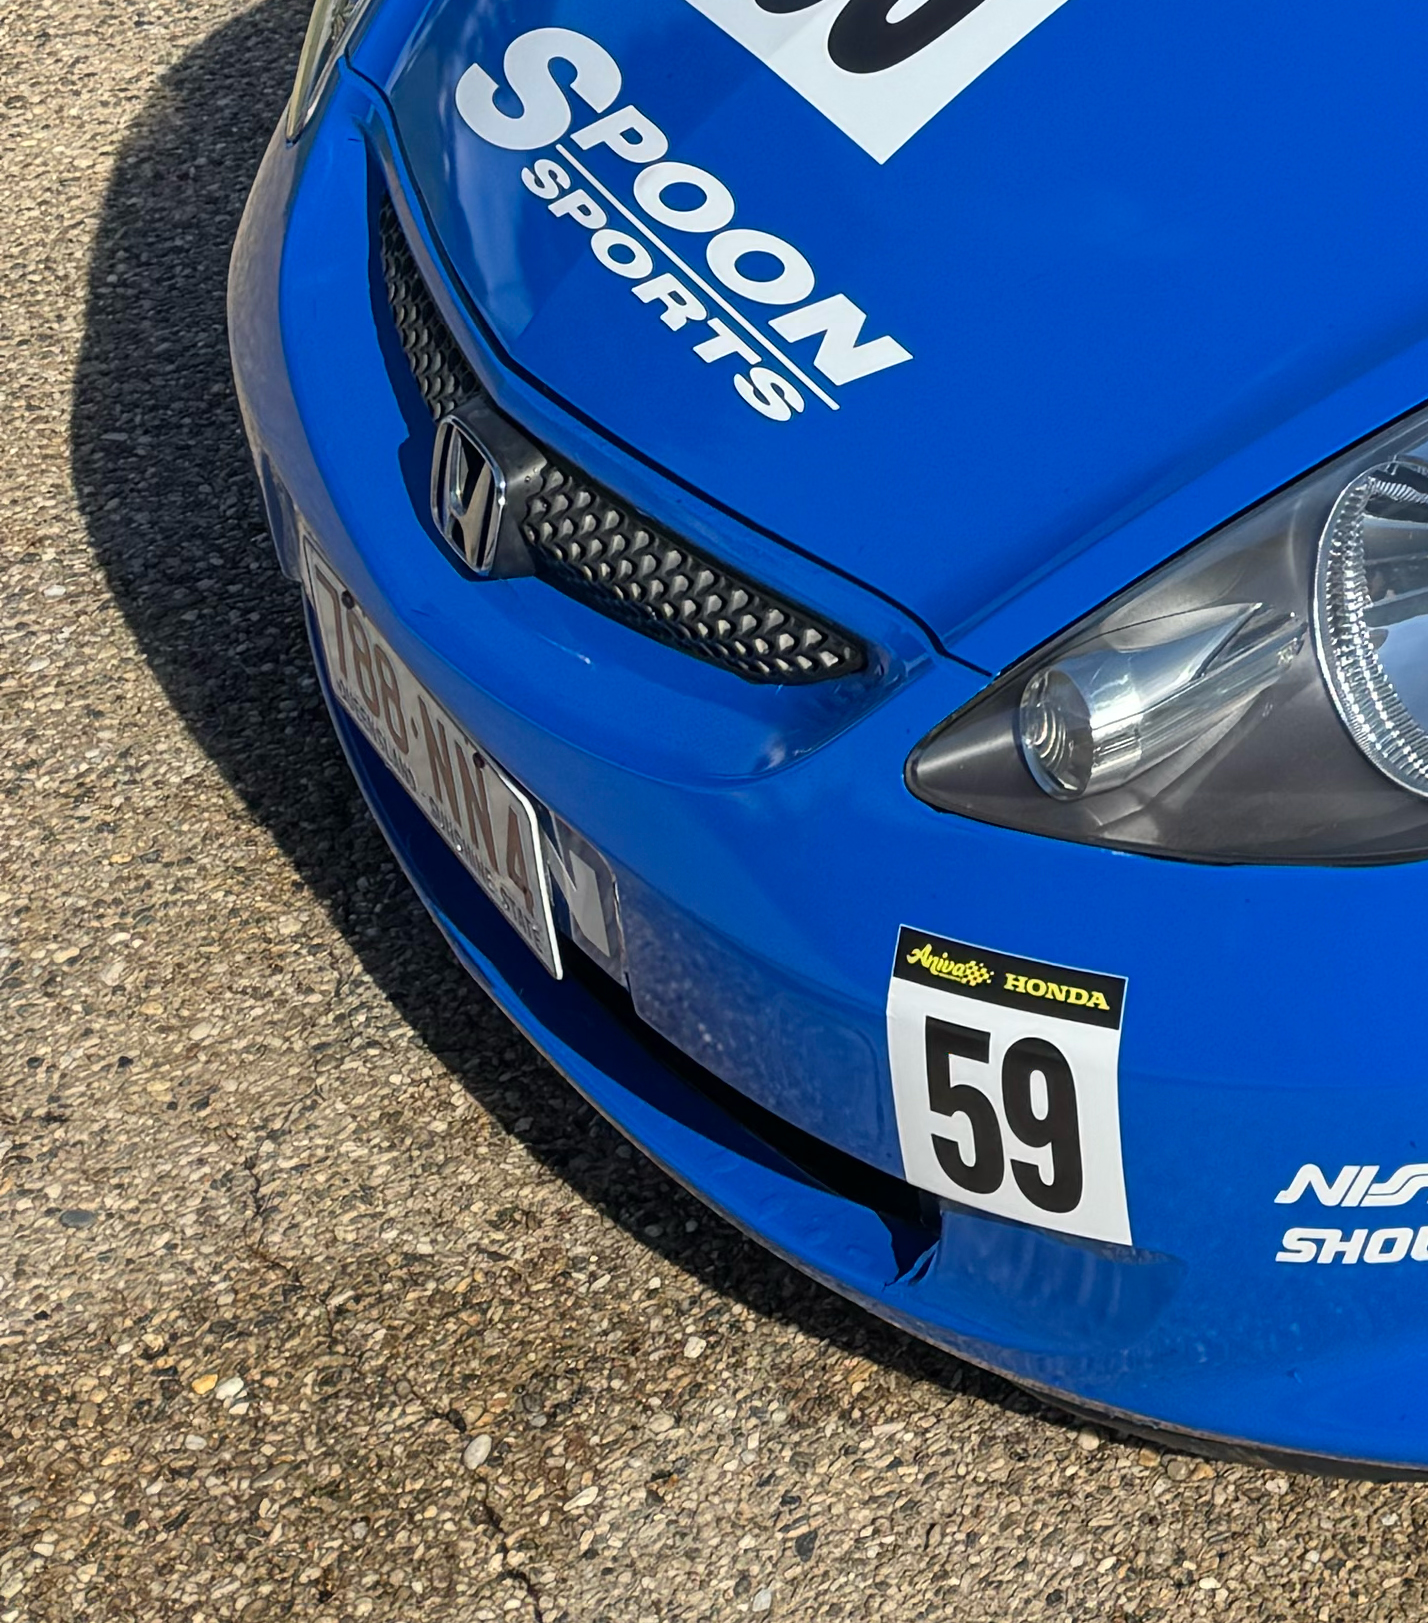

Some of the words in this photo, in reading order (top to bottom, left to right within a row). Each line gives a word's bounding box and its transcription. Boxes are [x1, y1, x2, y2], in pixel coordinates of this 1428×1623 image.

[455, 26, 914, 387] SPOON
[521, 157, 806, 422] SPORTS
[1003, 972, 1110, 1010] HONDA
[924, 1015, 1084, 1215] 59
